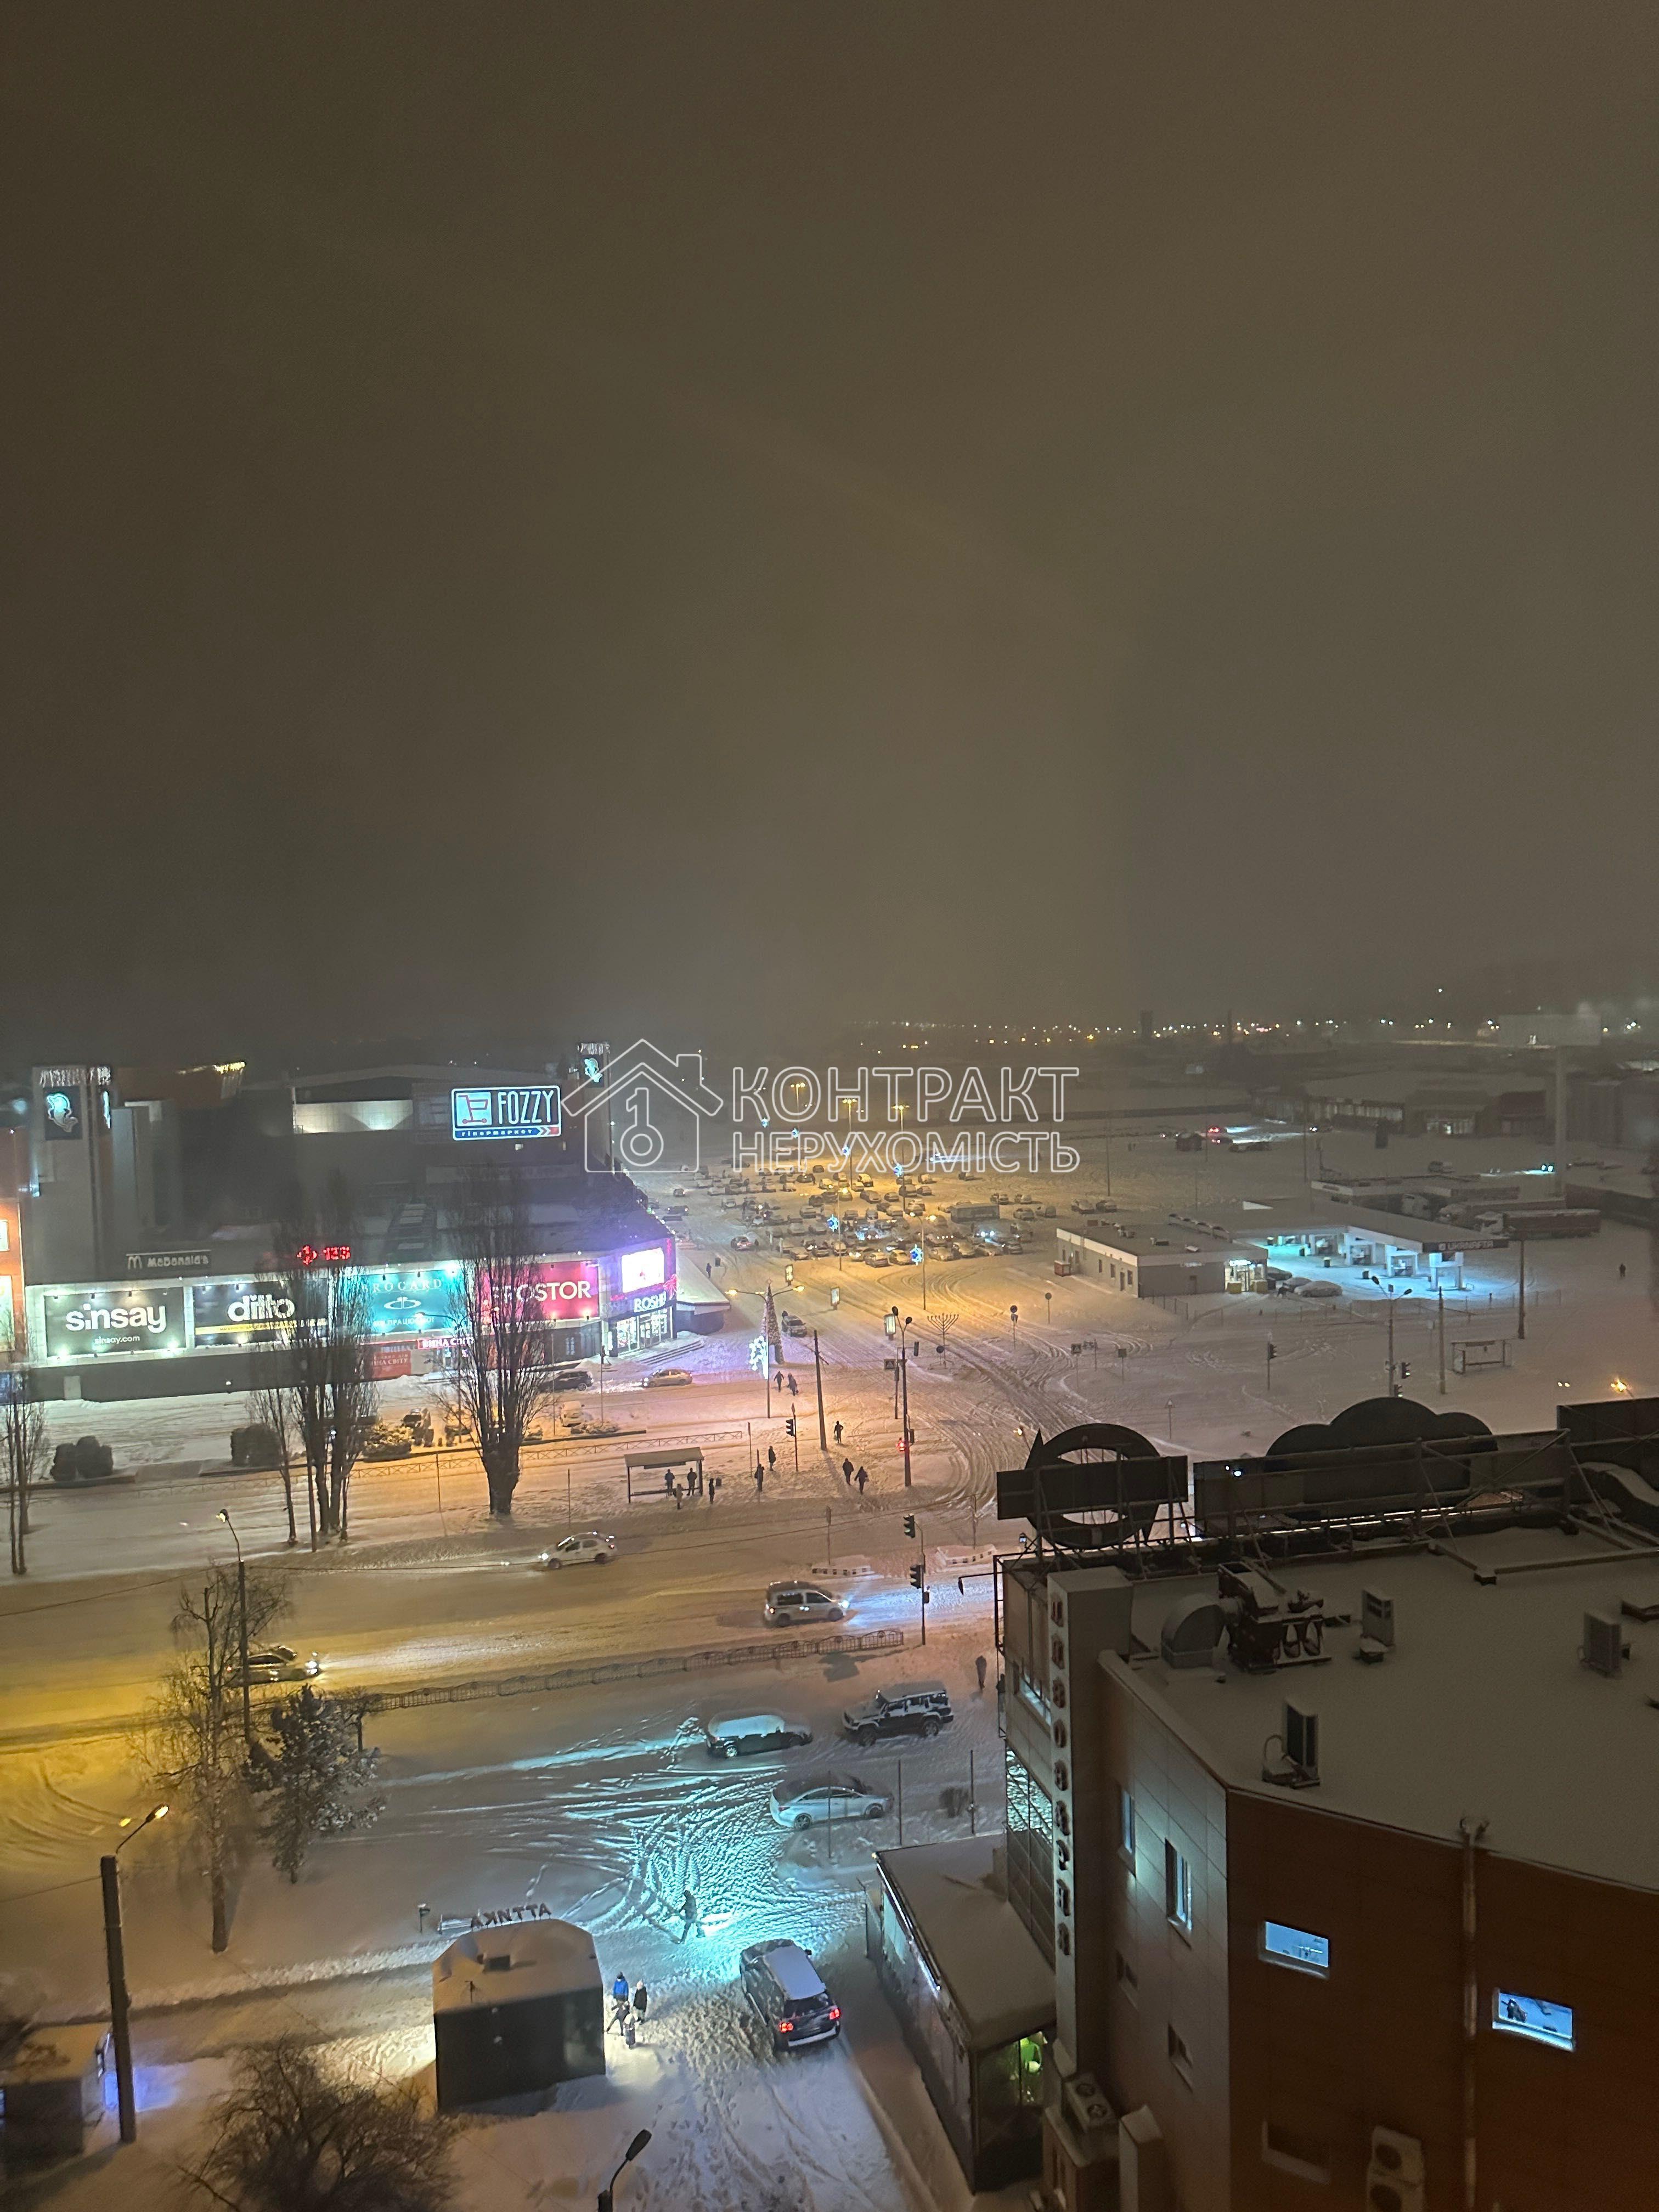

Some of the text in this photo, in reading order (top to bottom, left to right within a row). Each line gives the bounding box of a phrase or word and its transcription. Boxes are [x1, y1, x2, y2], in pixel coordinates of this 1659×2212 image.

[498, 1090, 554, 1125] FOZZY
[148, 1255, 209, 1268] McDonald's
[66, 1304, 166, 1334] sinsay
[94, 1335, 140, 1344] sinsay.com
